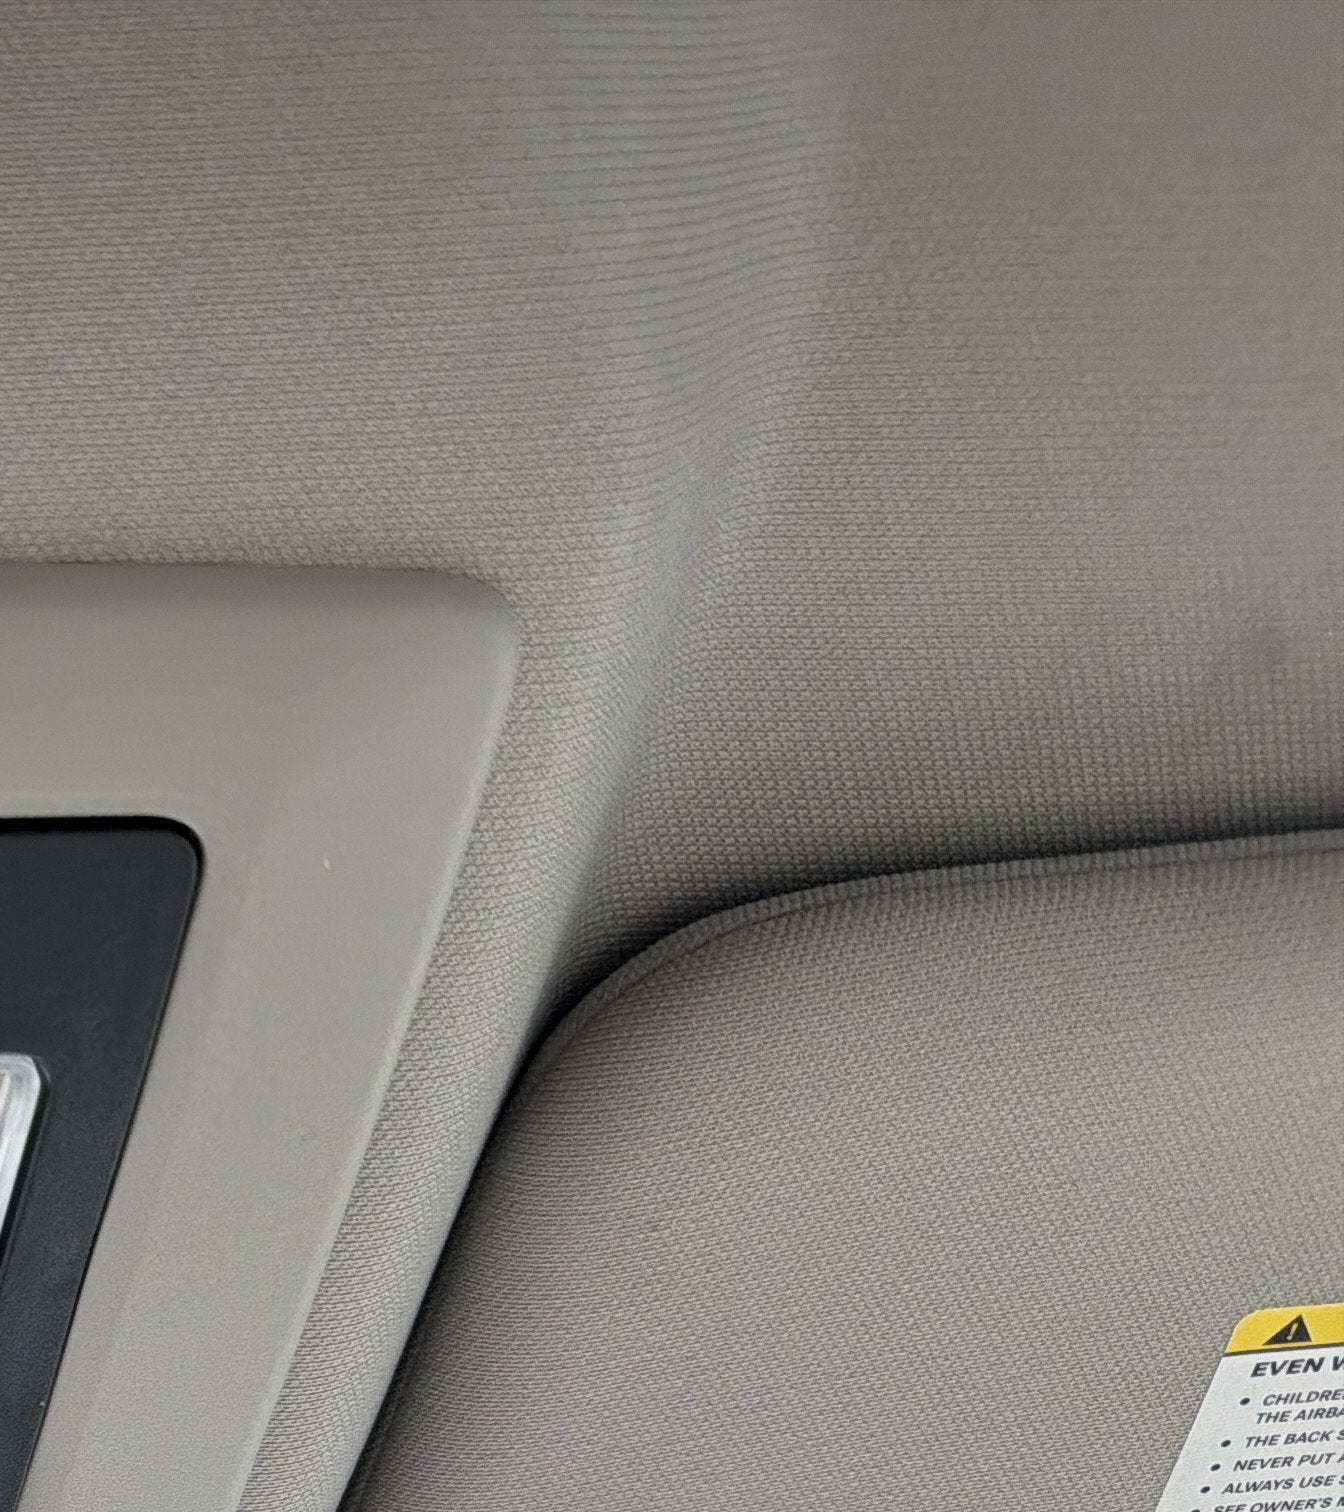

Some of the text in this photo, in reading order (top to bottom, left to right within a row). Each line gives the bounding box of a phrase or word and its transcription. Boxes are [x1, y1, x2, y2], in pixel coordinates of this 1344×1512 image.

[1250, 1357, 1326, 1377] EVEN
[1263, 1389, 1344, 1406] CHILDRE
[1256, 1410, 1292, 1424] THE
[1245, 1434, 1281, 1448] THE
[1283, 1430, 1335, 1445] BACK
[1233, 1456, 1295, 1471] NEVER
[1297, 1452, 1336, 1467] PUT
[1220, 1478, 1295, 1494] ALWAYS
[1299, 1475, 1337, 1489] USE
